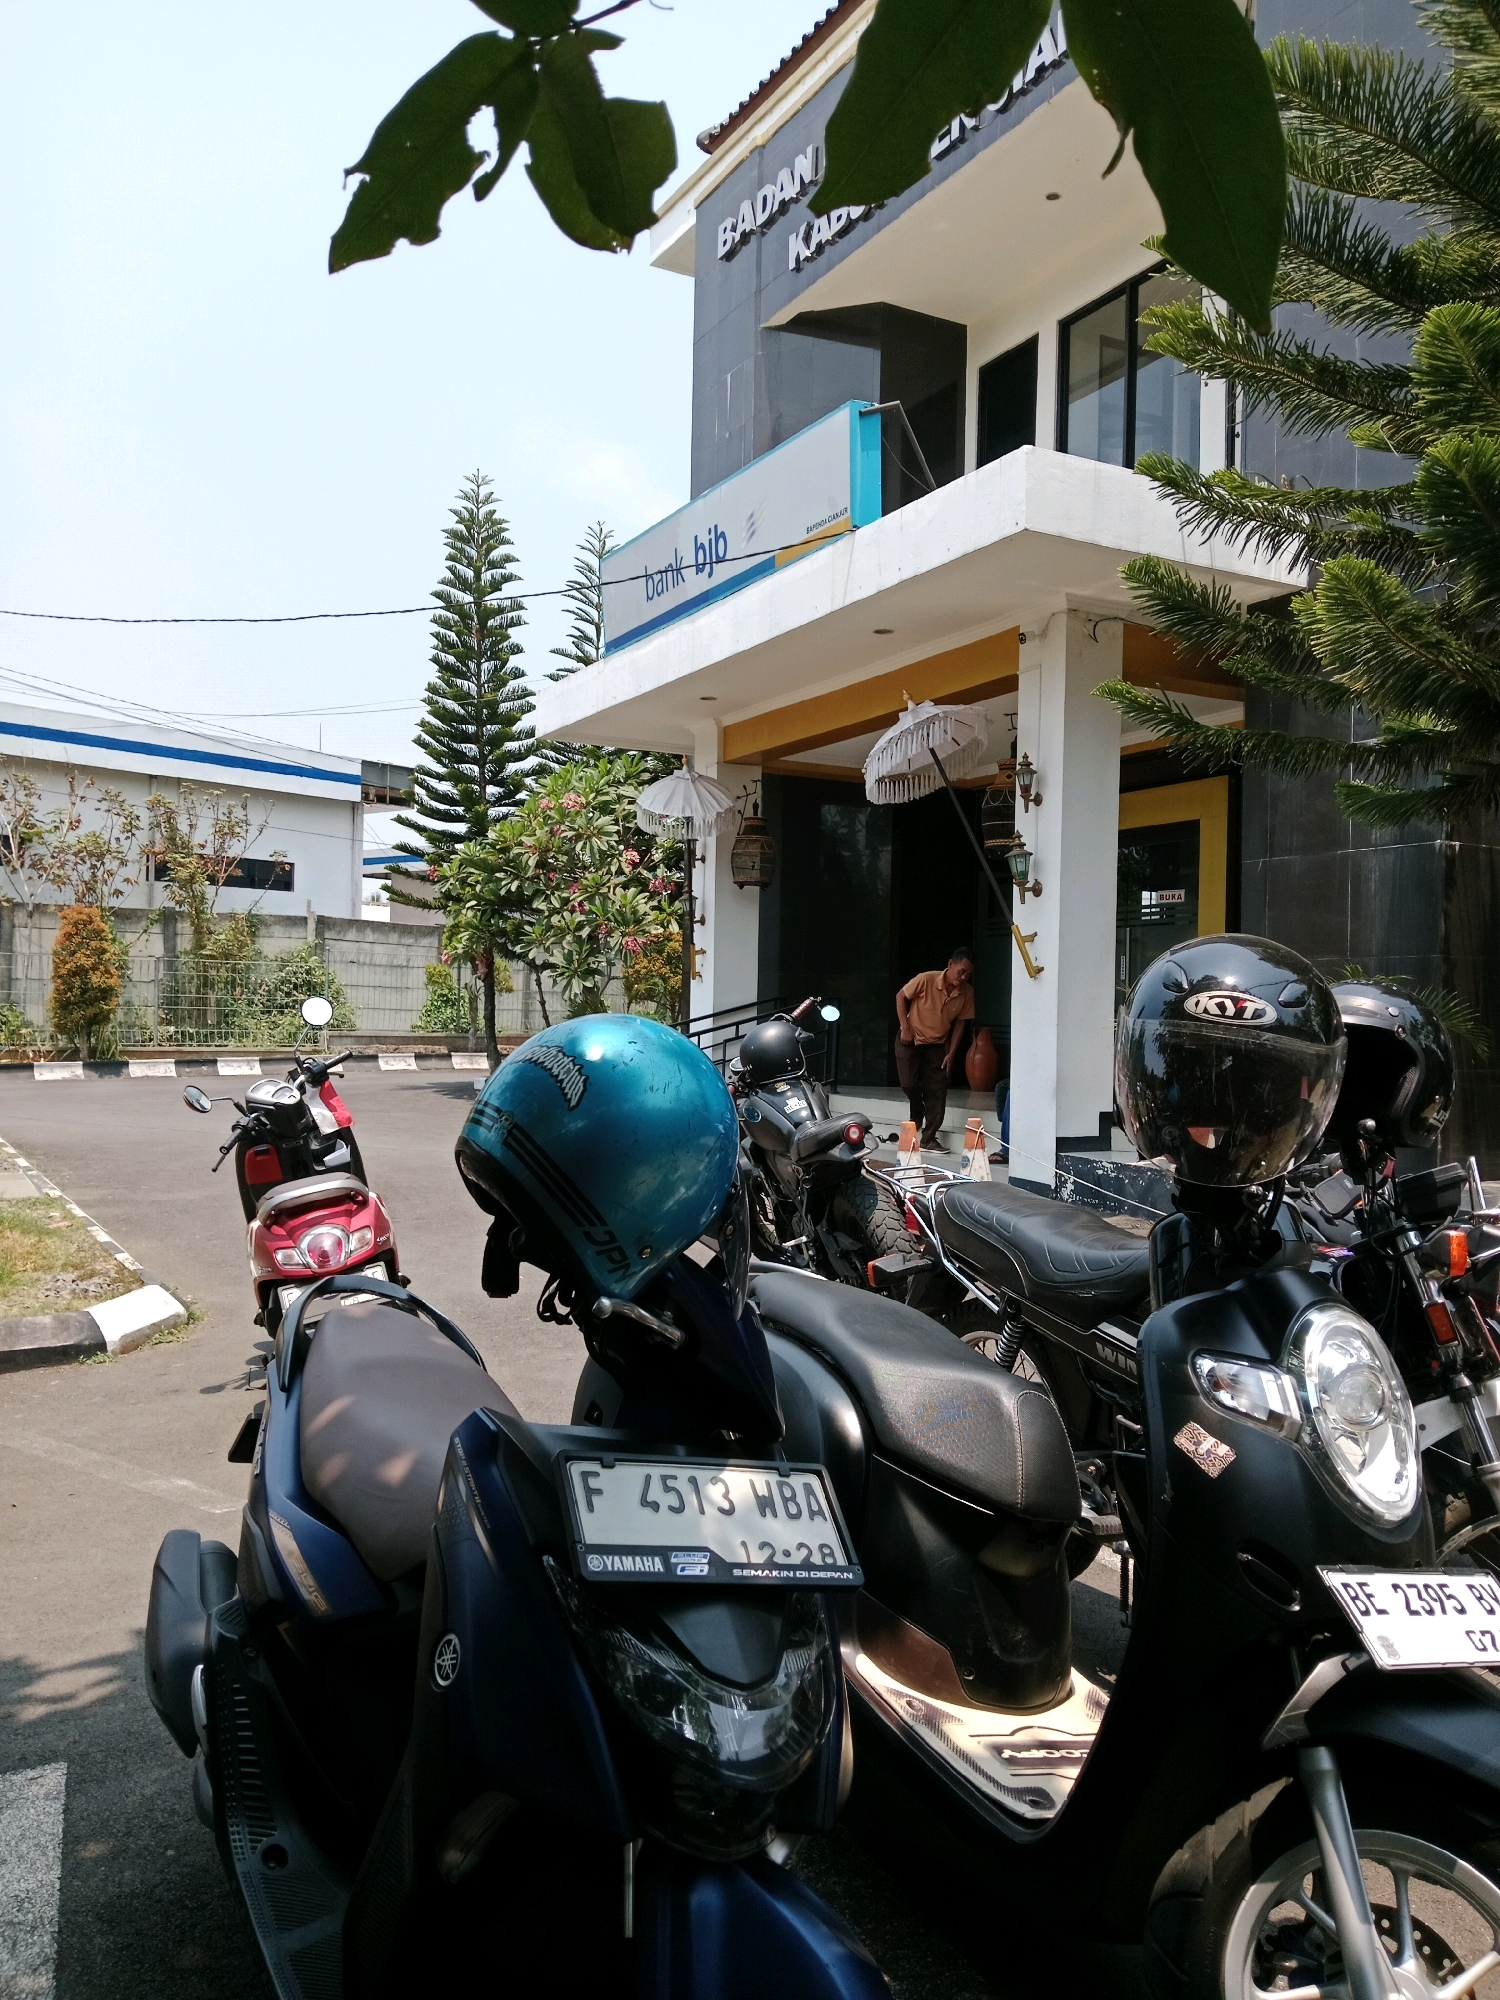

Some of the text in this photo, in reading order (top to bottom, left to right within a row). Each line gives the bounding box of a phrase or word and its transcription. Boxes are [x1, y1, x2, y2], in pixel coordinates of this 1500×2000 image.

[718, 144, 818, 261] BADAN
[644, 524, 728, 602] bank bjb
[1159, 893, 1182, 901] BUKA
[1192, 995, 1269, 1020] KYT
[582, 1229, 638, 1285] JPN
[454, 1437, 466, 1460] STOP
[579, 1471, 828, 1522] F 4513 WBA
[602, 1555, 664, 1572] YAMAHA
[733, 1568, 793, 1577] SEMAKIN
[810, 1571, 853, 1579] DEPAN
[1341, 1582, 1390, 1616] BE
[1391, 1583, 1467, 1616] 2395
